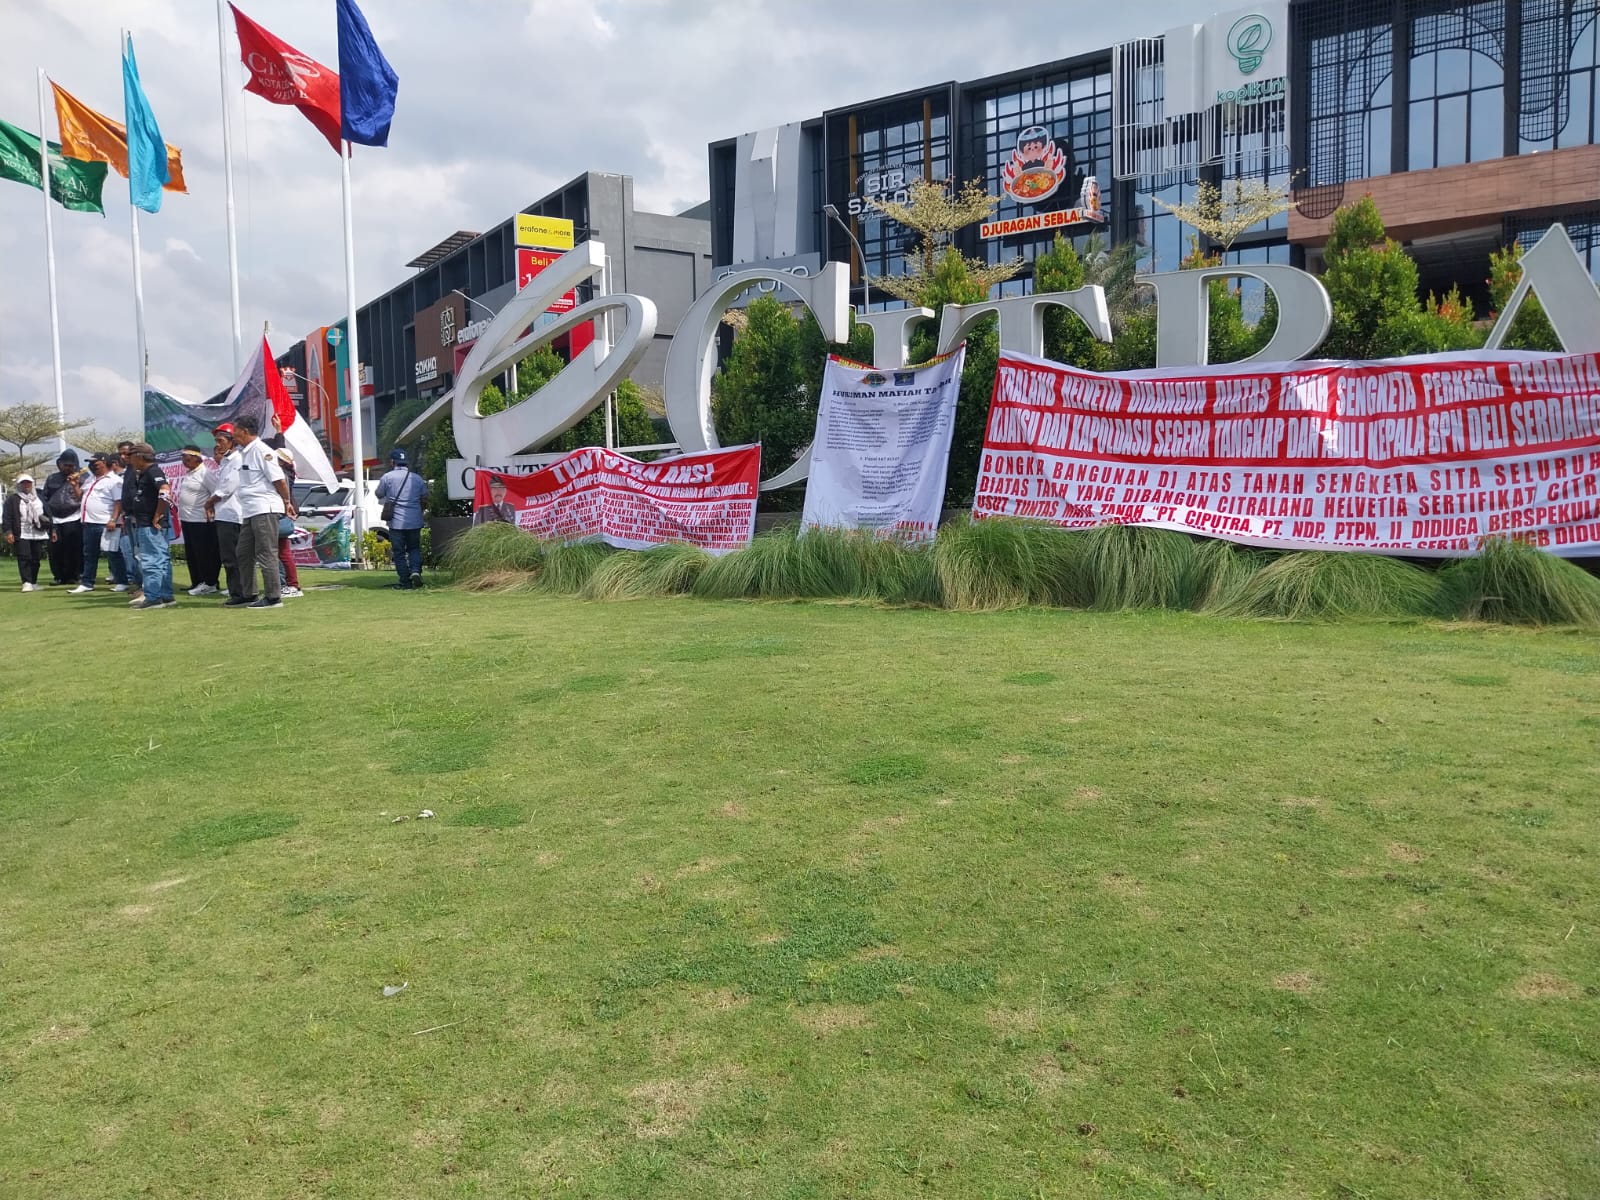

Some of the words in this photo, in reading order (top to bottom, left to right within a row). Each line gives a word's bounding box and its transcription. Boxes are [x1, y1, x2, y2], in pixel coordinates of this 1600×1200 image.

[867, 171, 906, 193] SIR
[848, 190, 914, 215] SALO
[520, 225, 547, 234] erafone
[982, 216, 1040, 237] DJURAGAN
[1044, 210, 1080, 227] SEBLA
[1061, 375, 1123, 412] HELVETIA
[1127, 380, 1206, 414] DIBANGUN
[1213, 377, 1271, 414] DIATAS
[1278, 373, 1329, 412] TANAH
[1336, 372, 1416, 416] SENGKETA
[1421, 366, 1504, 408] PERKARA
[1508, 353, 1600, 394] PERDATA
[1037, 412, 1071, 449] DAN
[1068, 415, 1152, 457] KAPOLDASU
[1153, 419, 1210, 458] SEGERA
[1214, 418, 1285, 459] TANGKAP
[1286, 417, 1321, 459] DAN
[1321, 419, 1365, 459] ADILI
[1368, 415, 1425, 461] KEPALA
[1428, 409, 1465, 455] BPN
[1467, 404, 1509, 451] DELI
[1510, 393, 1600, 447] SERDANG
[660, 463, 714, 484] AKSI
[1053, 462, 1149, 486] BANGUNAN
[1158, 470, 1177, 488] DI
[1186, 471, 1231, 493] ATAS
[1243, 473, 1304, 494] TANAH
[1316, 472, 1418, 495] SENGKETA
[1430, 466, 1481, 491] SITA
[1494, 451, 1600, 486] SELURUH
[979, 475, 1029, 497] DIATAS
[1076, 484, 1115, 502] YANG
[1122, 488, 1209, 510] DIBANGUN
[1217, 495, 1313, 517] CITRALAND
[1324, 496, 1408, 518] HELVETIA
[1419, 486, 1537, 516] SERTIFIKAT
[1547, 473, 1597, 501] CITR
[977, 494, 1009, 512] USUT
[1014, 499, 1059, 518] TUNTAS
[1100, 504, 1145, 520] TANAH
[1185, 510, 1252, 533] CIPUTRA,
[1262, 520, 1283, 536] PT.
[1334, 521, 1379, 540] PTPN.
[1390, 521, 1402, 540] II
[1411, 517, 1478, 539] DIDUGA
